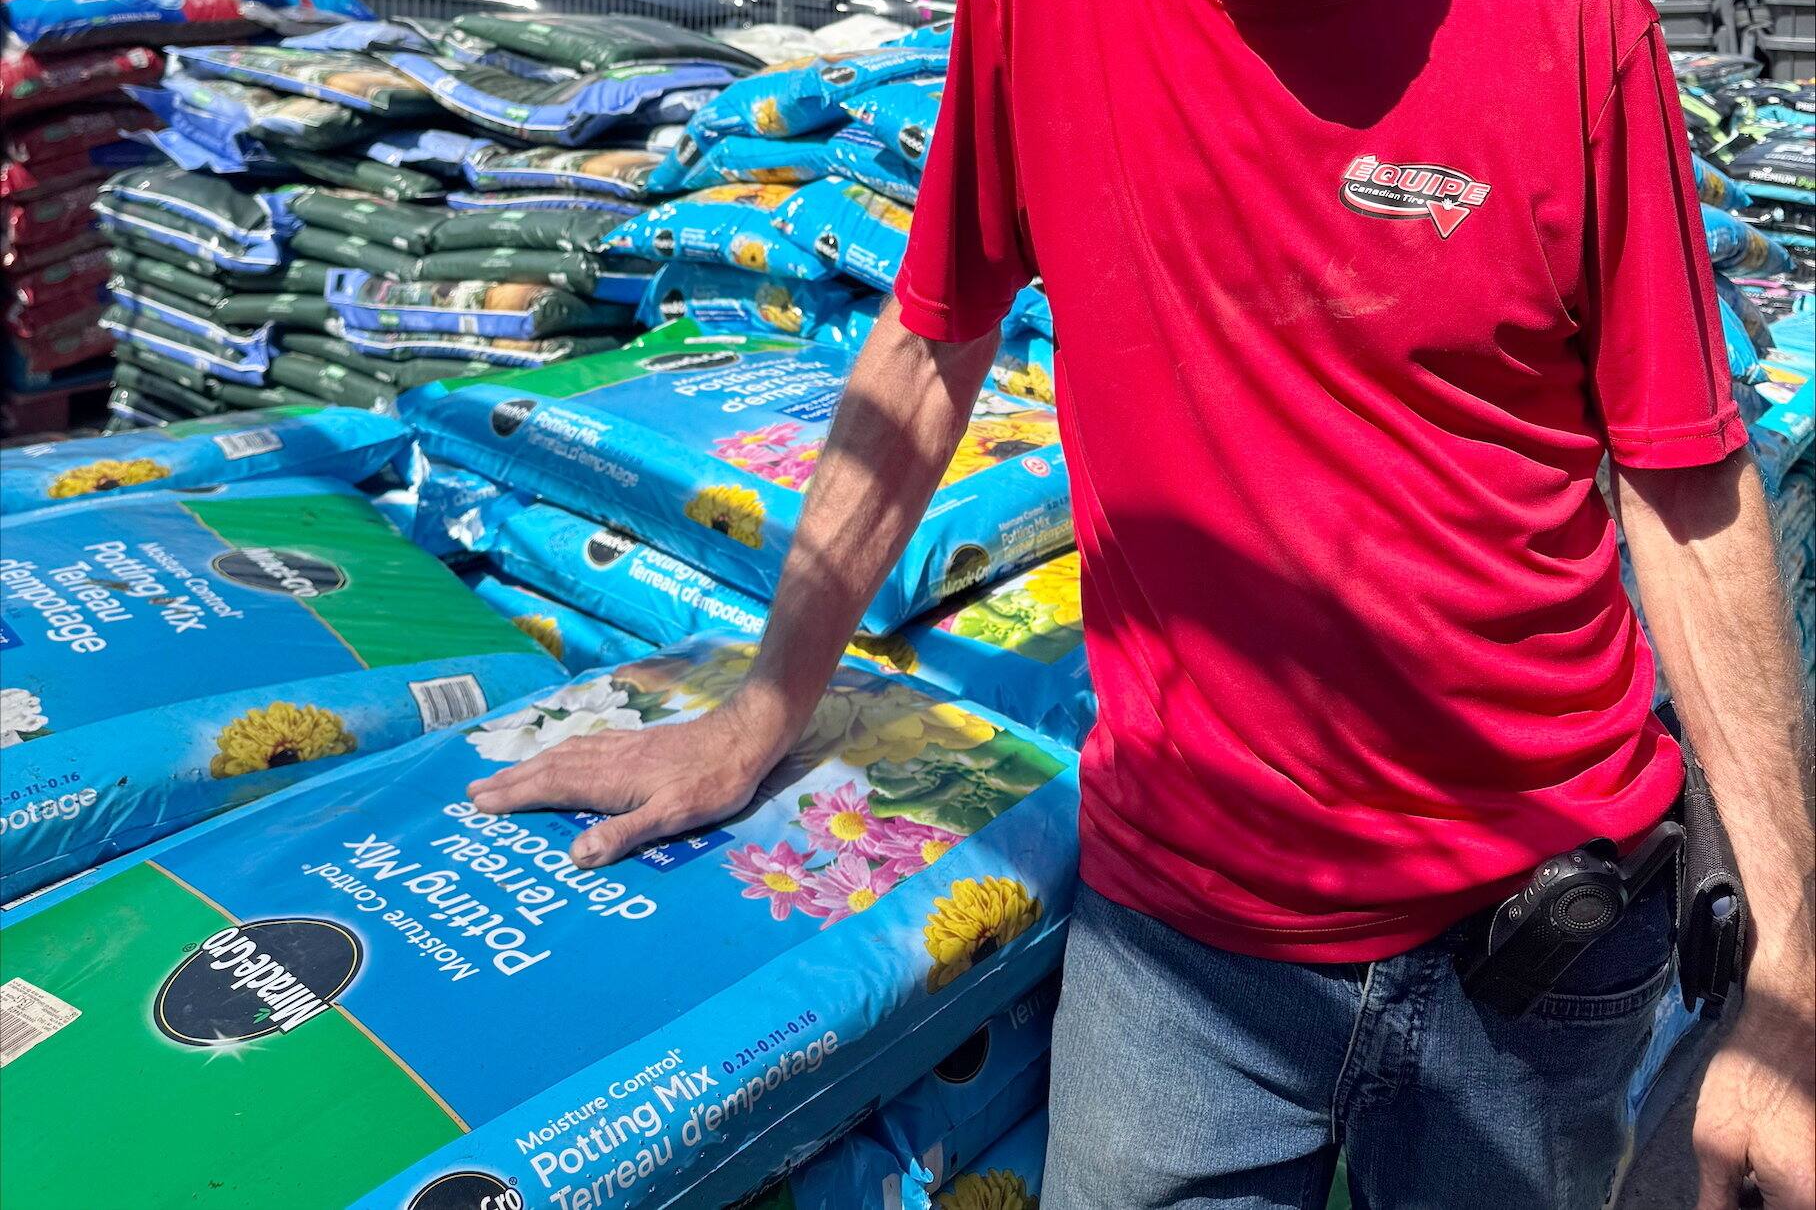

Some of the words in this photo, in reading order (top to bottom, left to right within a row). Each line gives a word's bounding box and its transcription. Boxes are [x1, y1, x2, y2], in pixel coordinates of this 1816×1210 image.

[1343, 155, 1492, 207] ÉQUIPE
[1349, 182, 1401, 201] Canadian
[1402, 193, 1425, 206] Tire
[534, 410, 579, 440] Potting
[575, 426, 602, 448] Mix
[567, 444, 640, 488] d'empotage
[1001, 523, 1036, 547] Potting
[1034, 516, 1050, 533] Mix
[48, 561, 133, 624] Terreau
[84, 540, 168, 598] Potting
[160, 595, 207, 633] Mix
[138, 542, 193, 580] Moisture
[185, 577, 238, 619] Control
[628, 557, 681, 597] Terreau
[680, 588, 766, 634] d'empotage
[342, 832, 422, 881] Mix
[430, 834, 568, 927] Terreau
[382, 909, 481, 982] Moisture
[401, 869, 552, 977] Potting
[202, 927, 330, 1032] Miracle-Gro
[515, 1096, 609, 1156] Moisture
[529, 1101, 663, 1189] Potting
[652, 1064, 720, 1115] Mix
[721, 1009, 818, 1075] 0.21-0.11-0.16
[550, 1135, 673, 1210] Terreau
[681, 1030, 839, 1148] d'empotage
